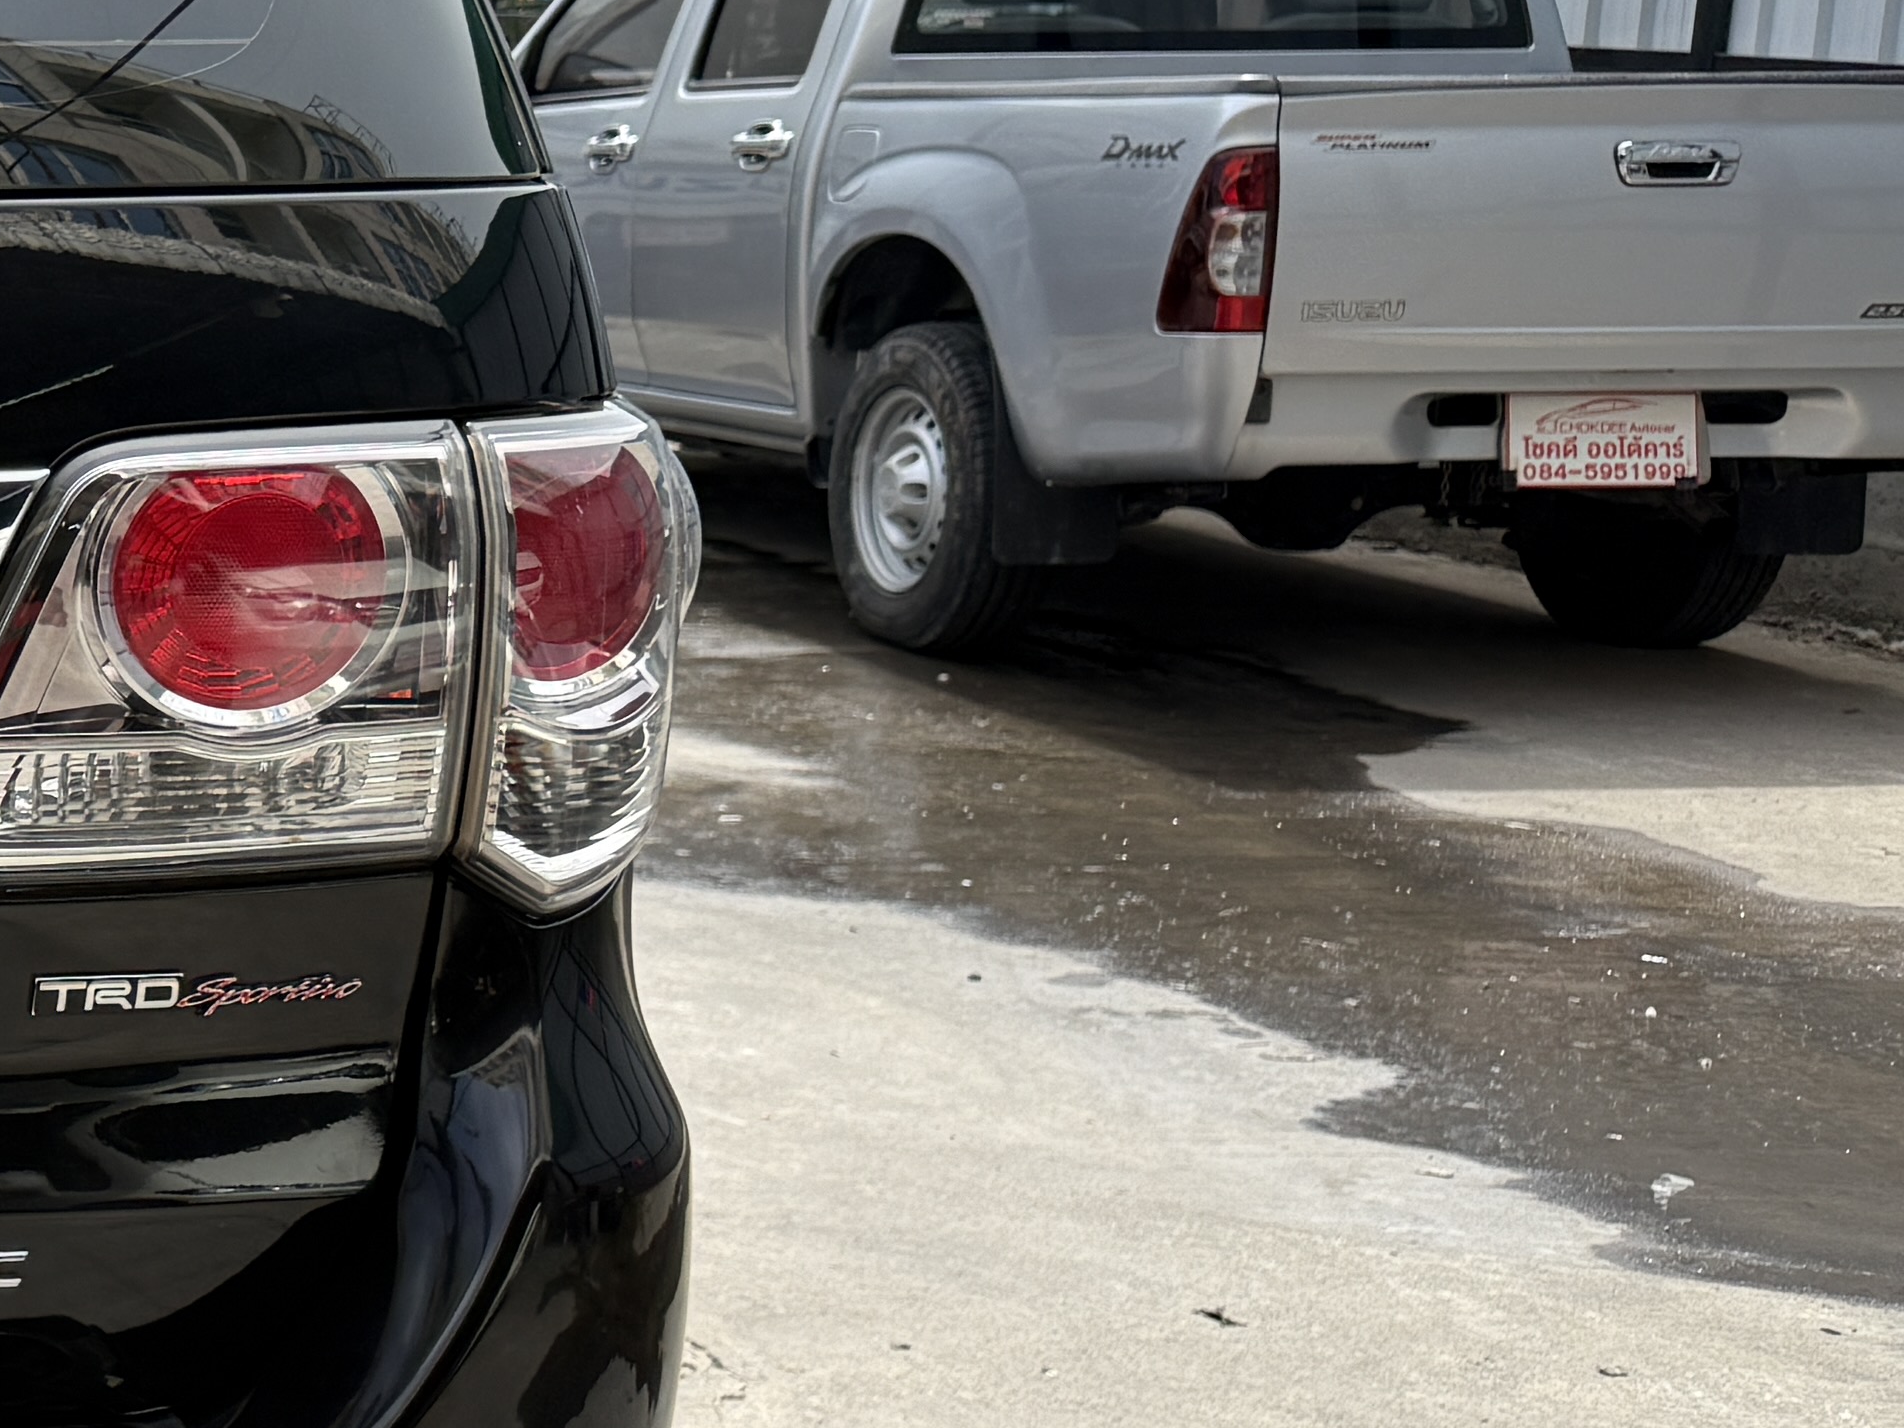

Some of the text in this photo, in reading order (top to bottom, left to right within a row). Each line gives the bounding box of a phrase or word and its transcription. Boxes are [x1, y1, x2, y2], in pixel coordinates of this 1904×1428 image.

[1301, 299, 1406, 322] ISUZU
[1629, 423, 1677, 434] Autocar
[1523, 436, 1685, 459] โชคดี ออโต้คาร์
[1523, 462, 1686, 481] 084-5951999
[33, 974, 181, 1014] TRD
